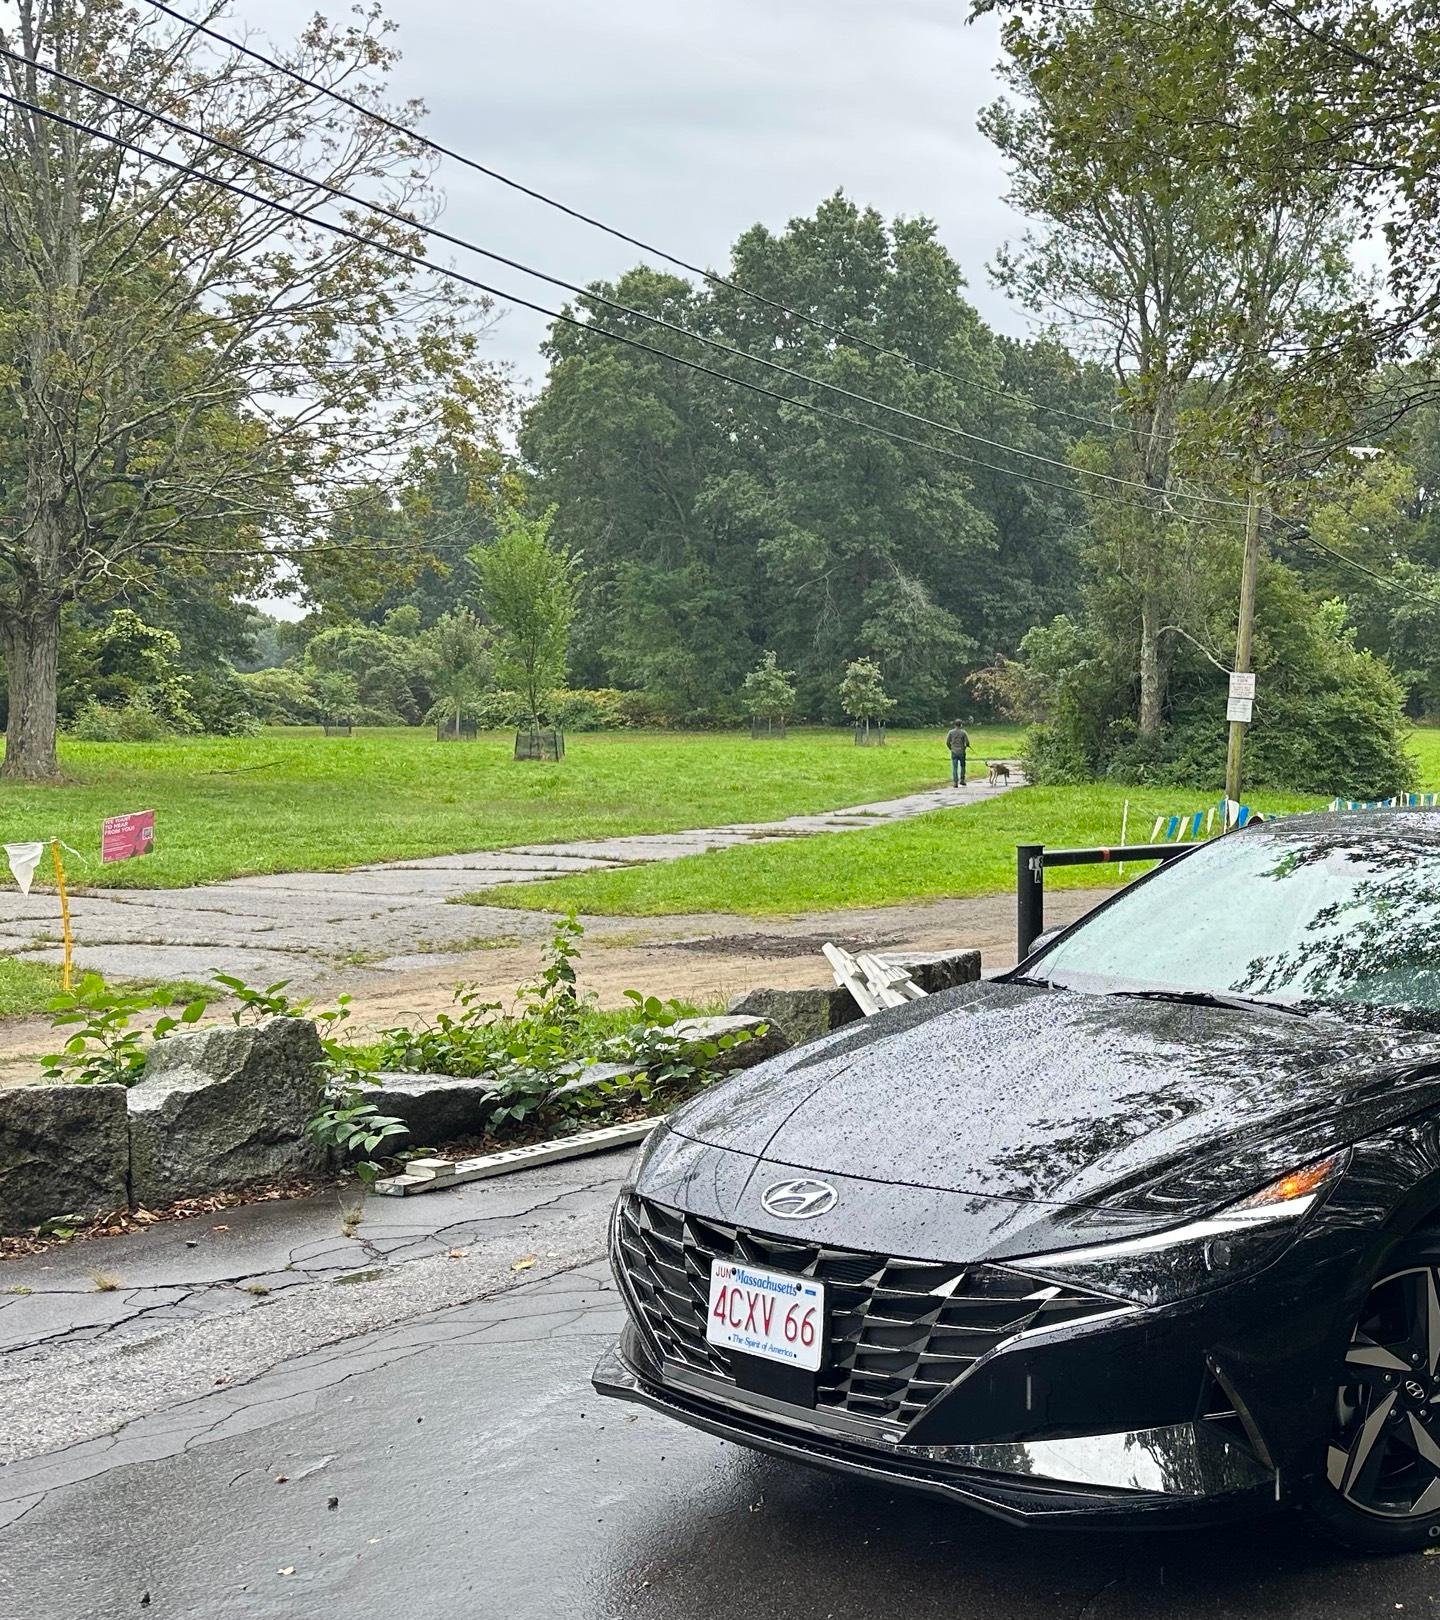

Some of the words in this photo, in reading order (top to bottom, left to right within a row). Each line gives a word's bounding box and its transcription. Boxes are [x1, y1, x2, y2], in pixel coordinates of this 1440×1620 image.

[488, 1136, 593, 1161] PARKING
[716, 1266, 731, 1279] JUN
[735, 1268, 797, 1297] Massachusetts
[713, 1285, 776, 1336] 4CXV
[784, 1303, 817, 1346] 66
[732, 1334, 744, 1344] The
[744, 1337, 760, 1349] Spirit
[761, 1342, 768, 1352] of
[768, 1344, 793, 1357] America
